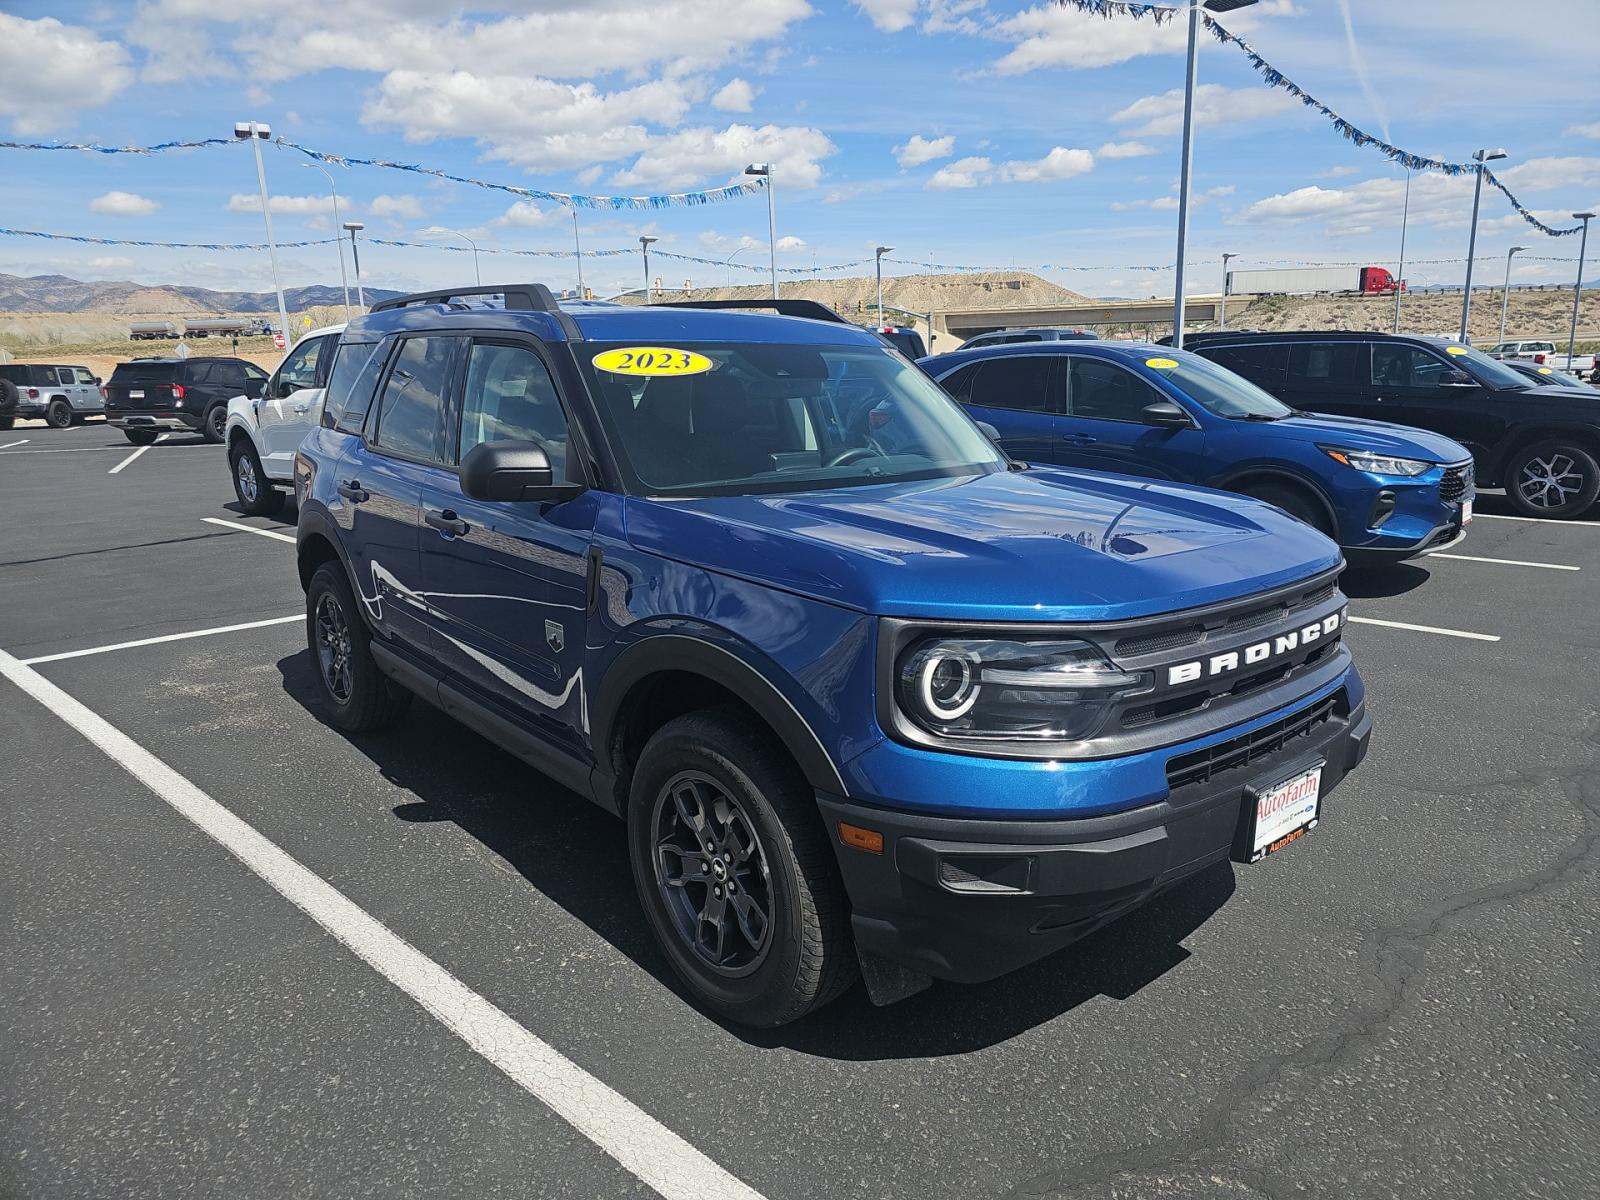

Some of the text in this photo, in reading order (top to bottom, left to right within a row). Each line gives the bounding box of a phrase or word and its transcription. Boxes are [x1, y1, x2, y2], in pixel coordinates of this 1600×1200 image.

[617, 353, 691, 369] 2023
[1168, 613, 1340, 686] BRONCO
[1257, 776, 1316, 819] AutoFarm
[1270, 828, 1304, 852] AutoFarm
